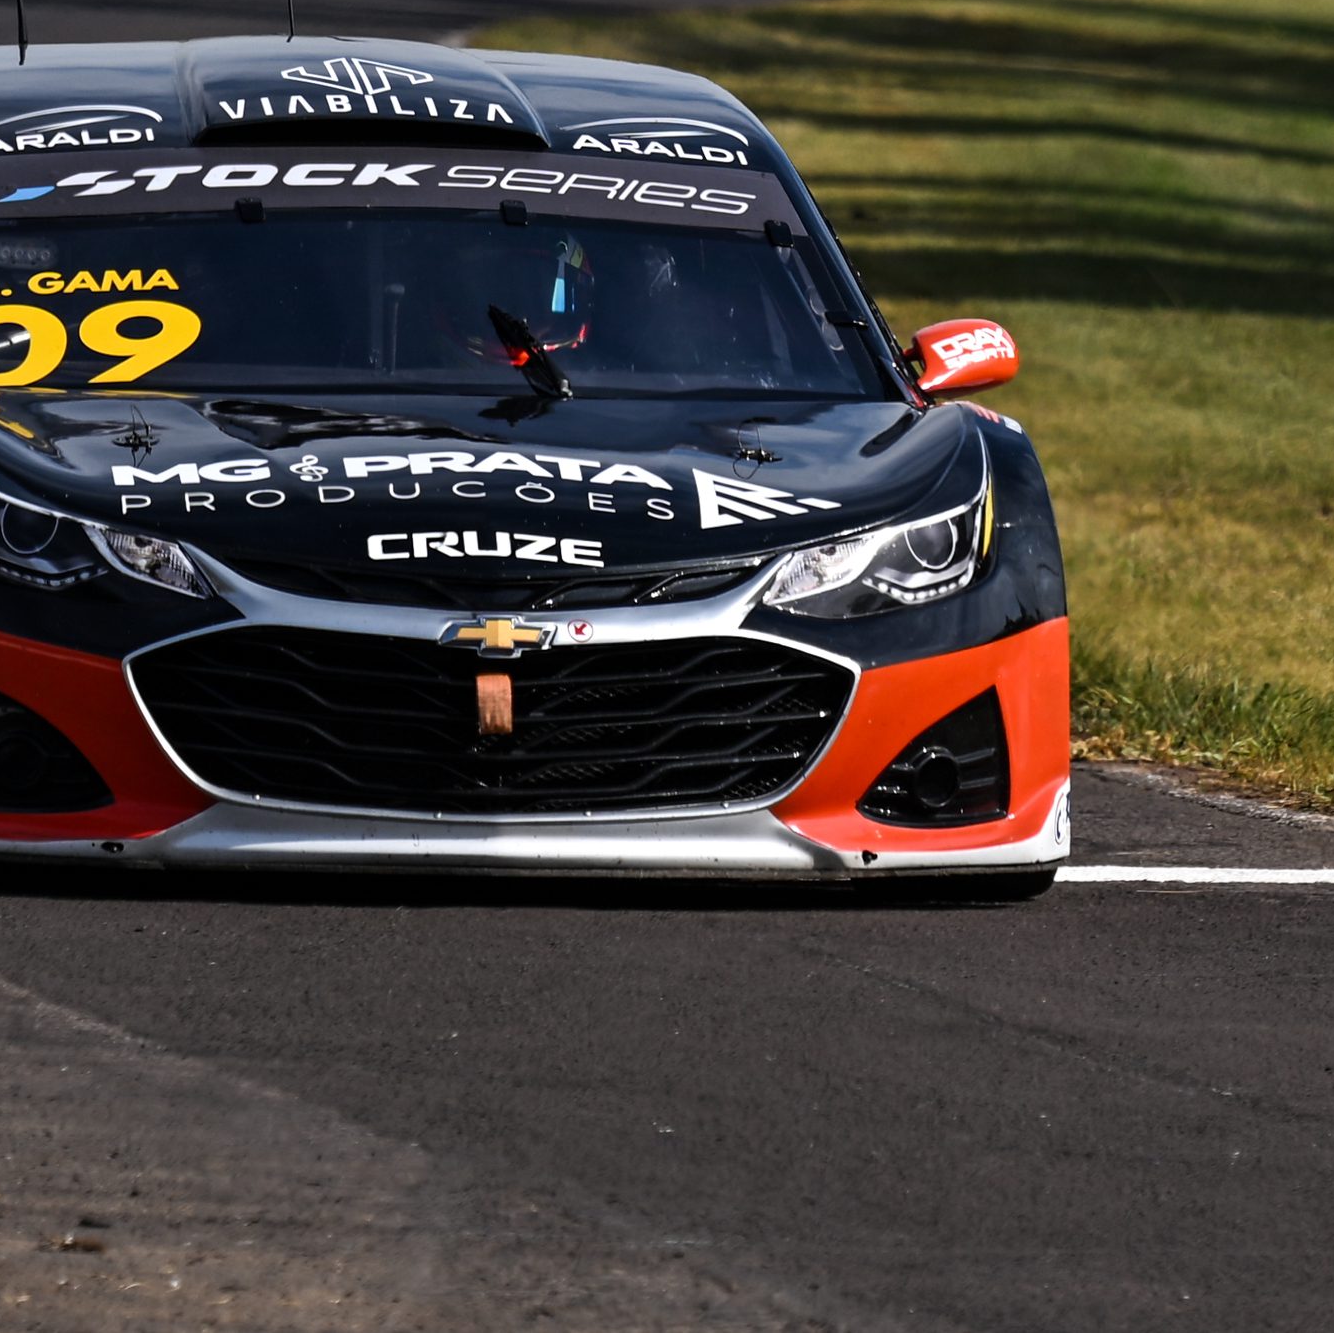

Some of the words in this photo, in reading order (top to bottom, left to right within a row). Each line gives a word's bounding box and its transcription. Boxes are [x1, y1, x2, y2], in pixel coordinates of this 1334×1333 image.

[218, 93, 514, 124] VIABILIZA
[572, 132, 749, 166] ARALDI
[438, 161, 757, 215] SERIES
[27, 268, 180, 295] GAMA
[931, 327, 1015, 360] DRAX
[111, 458, 271, 486] MG
[343, 451, 673, 491] PRATA
[367, 530, 605, 568] CRUZE
